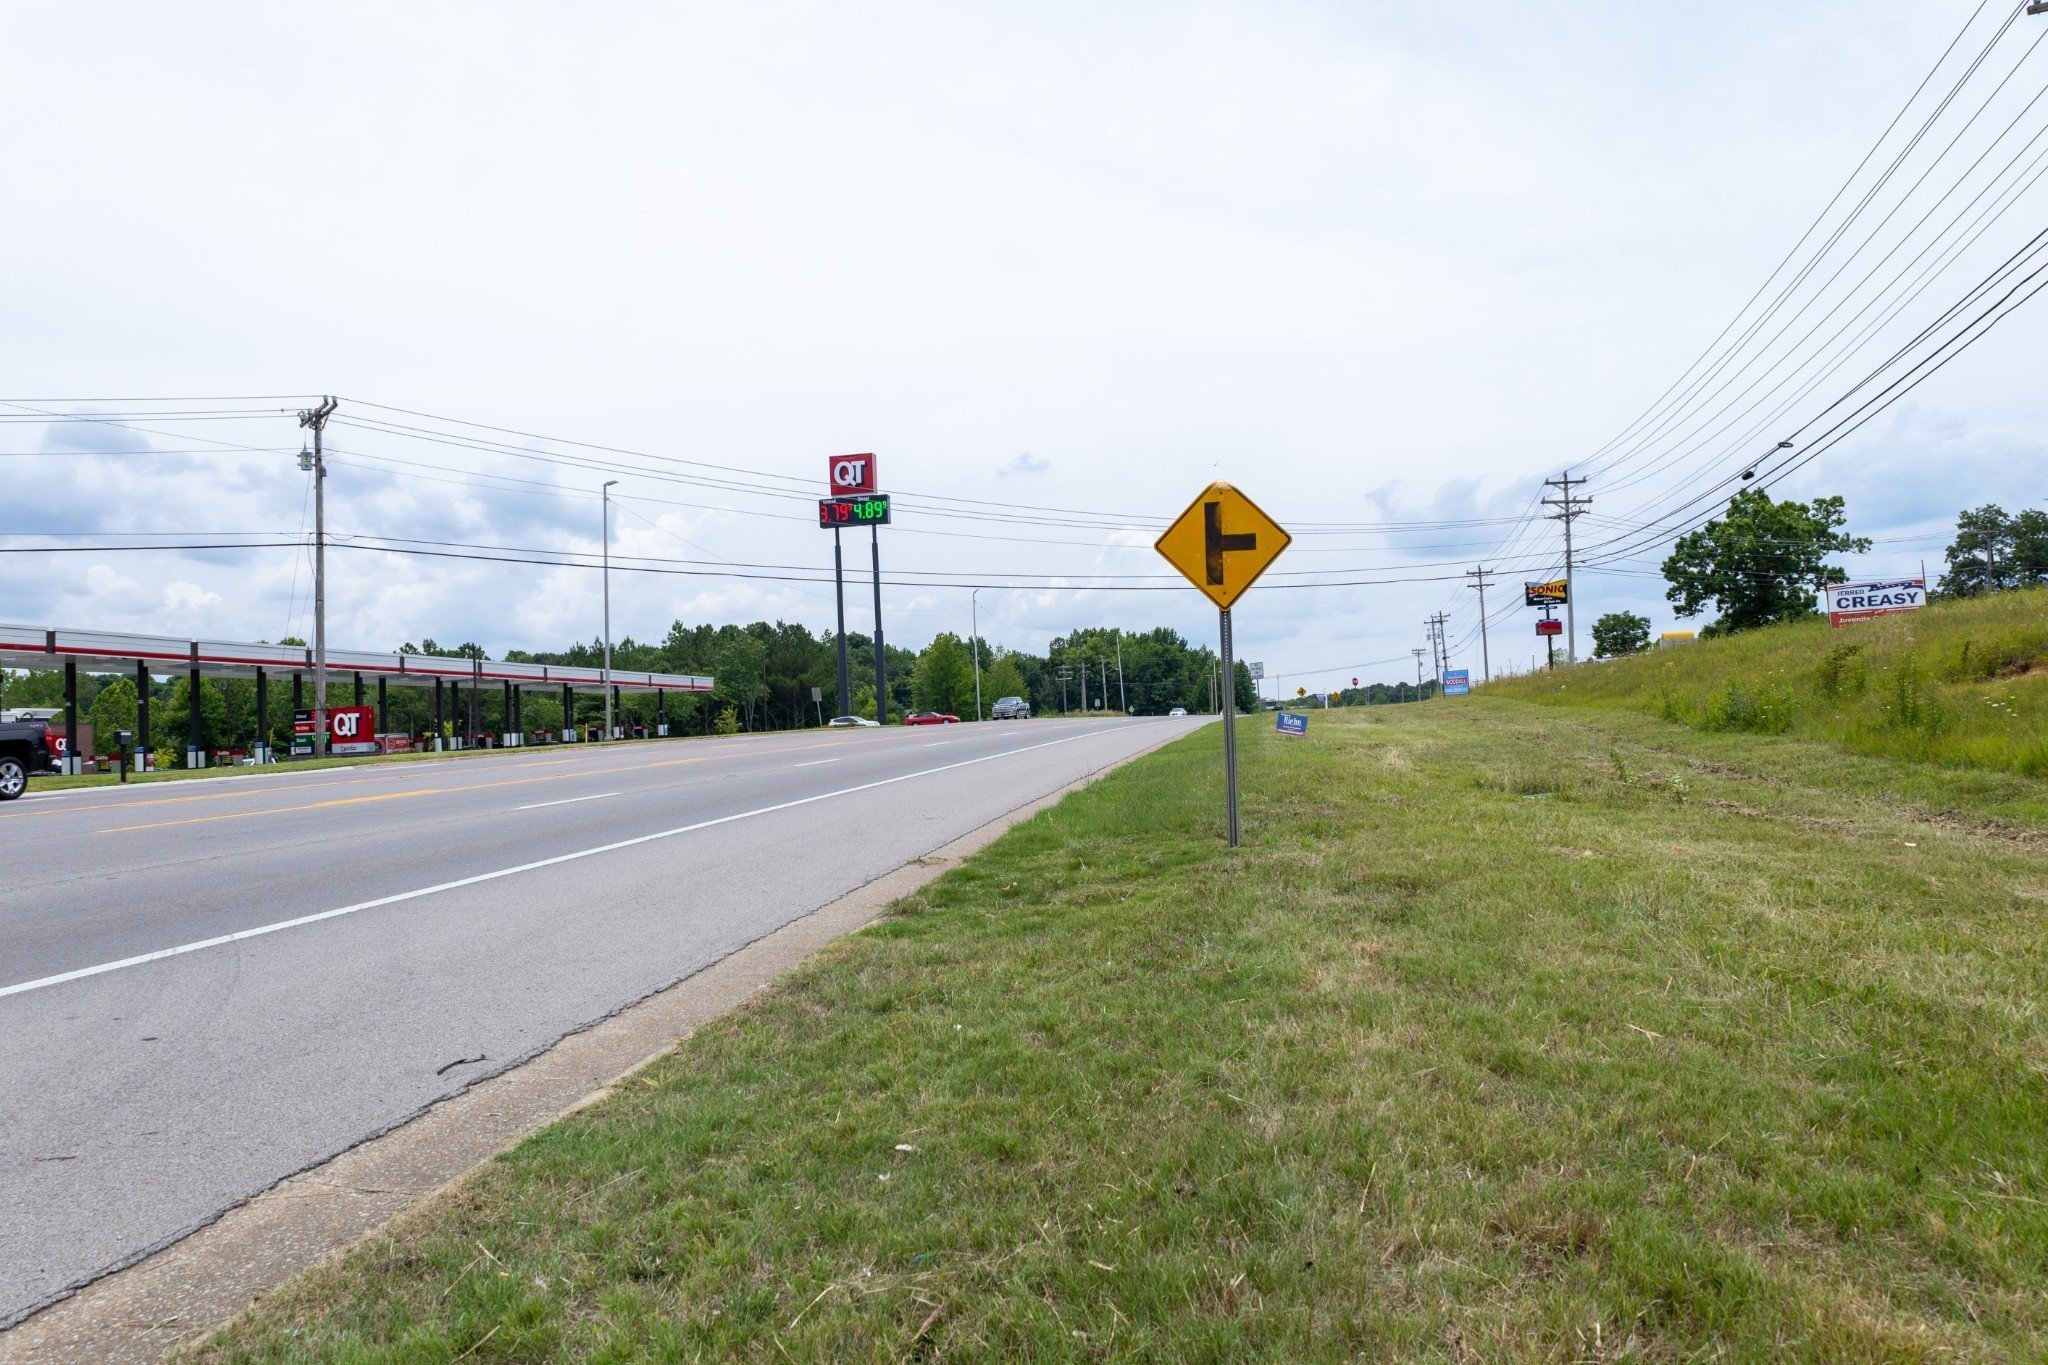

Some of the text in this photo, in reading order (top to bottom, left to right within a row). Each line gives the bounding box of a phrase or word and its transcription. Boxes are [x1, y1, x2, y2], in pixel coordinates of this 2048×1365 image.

[834, 460, 865, 487] QT
[1531, 585, 1563, 594] SONIC
[1836, 592, 1918, 609] CREASY
[1838, 615, 1871, 624] Juvenile
[334, 713, 360, 737] QT
